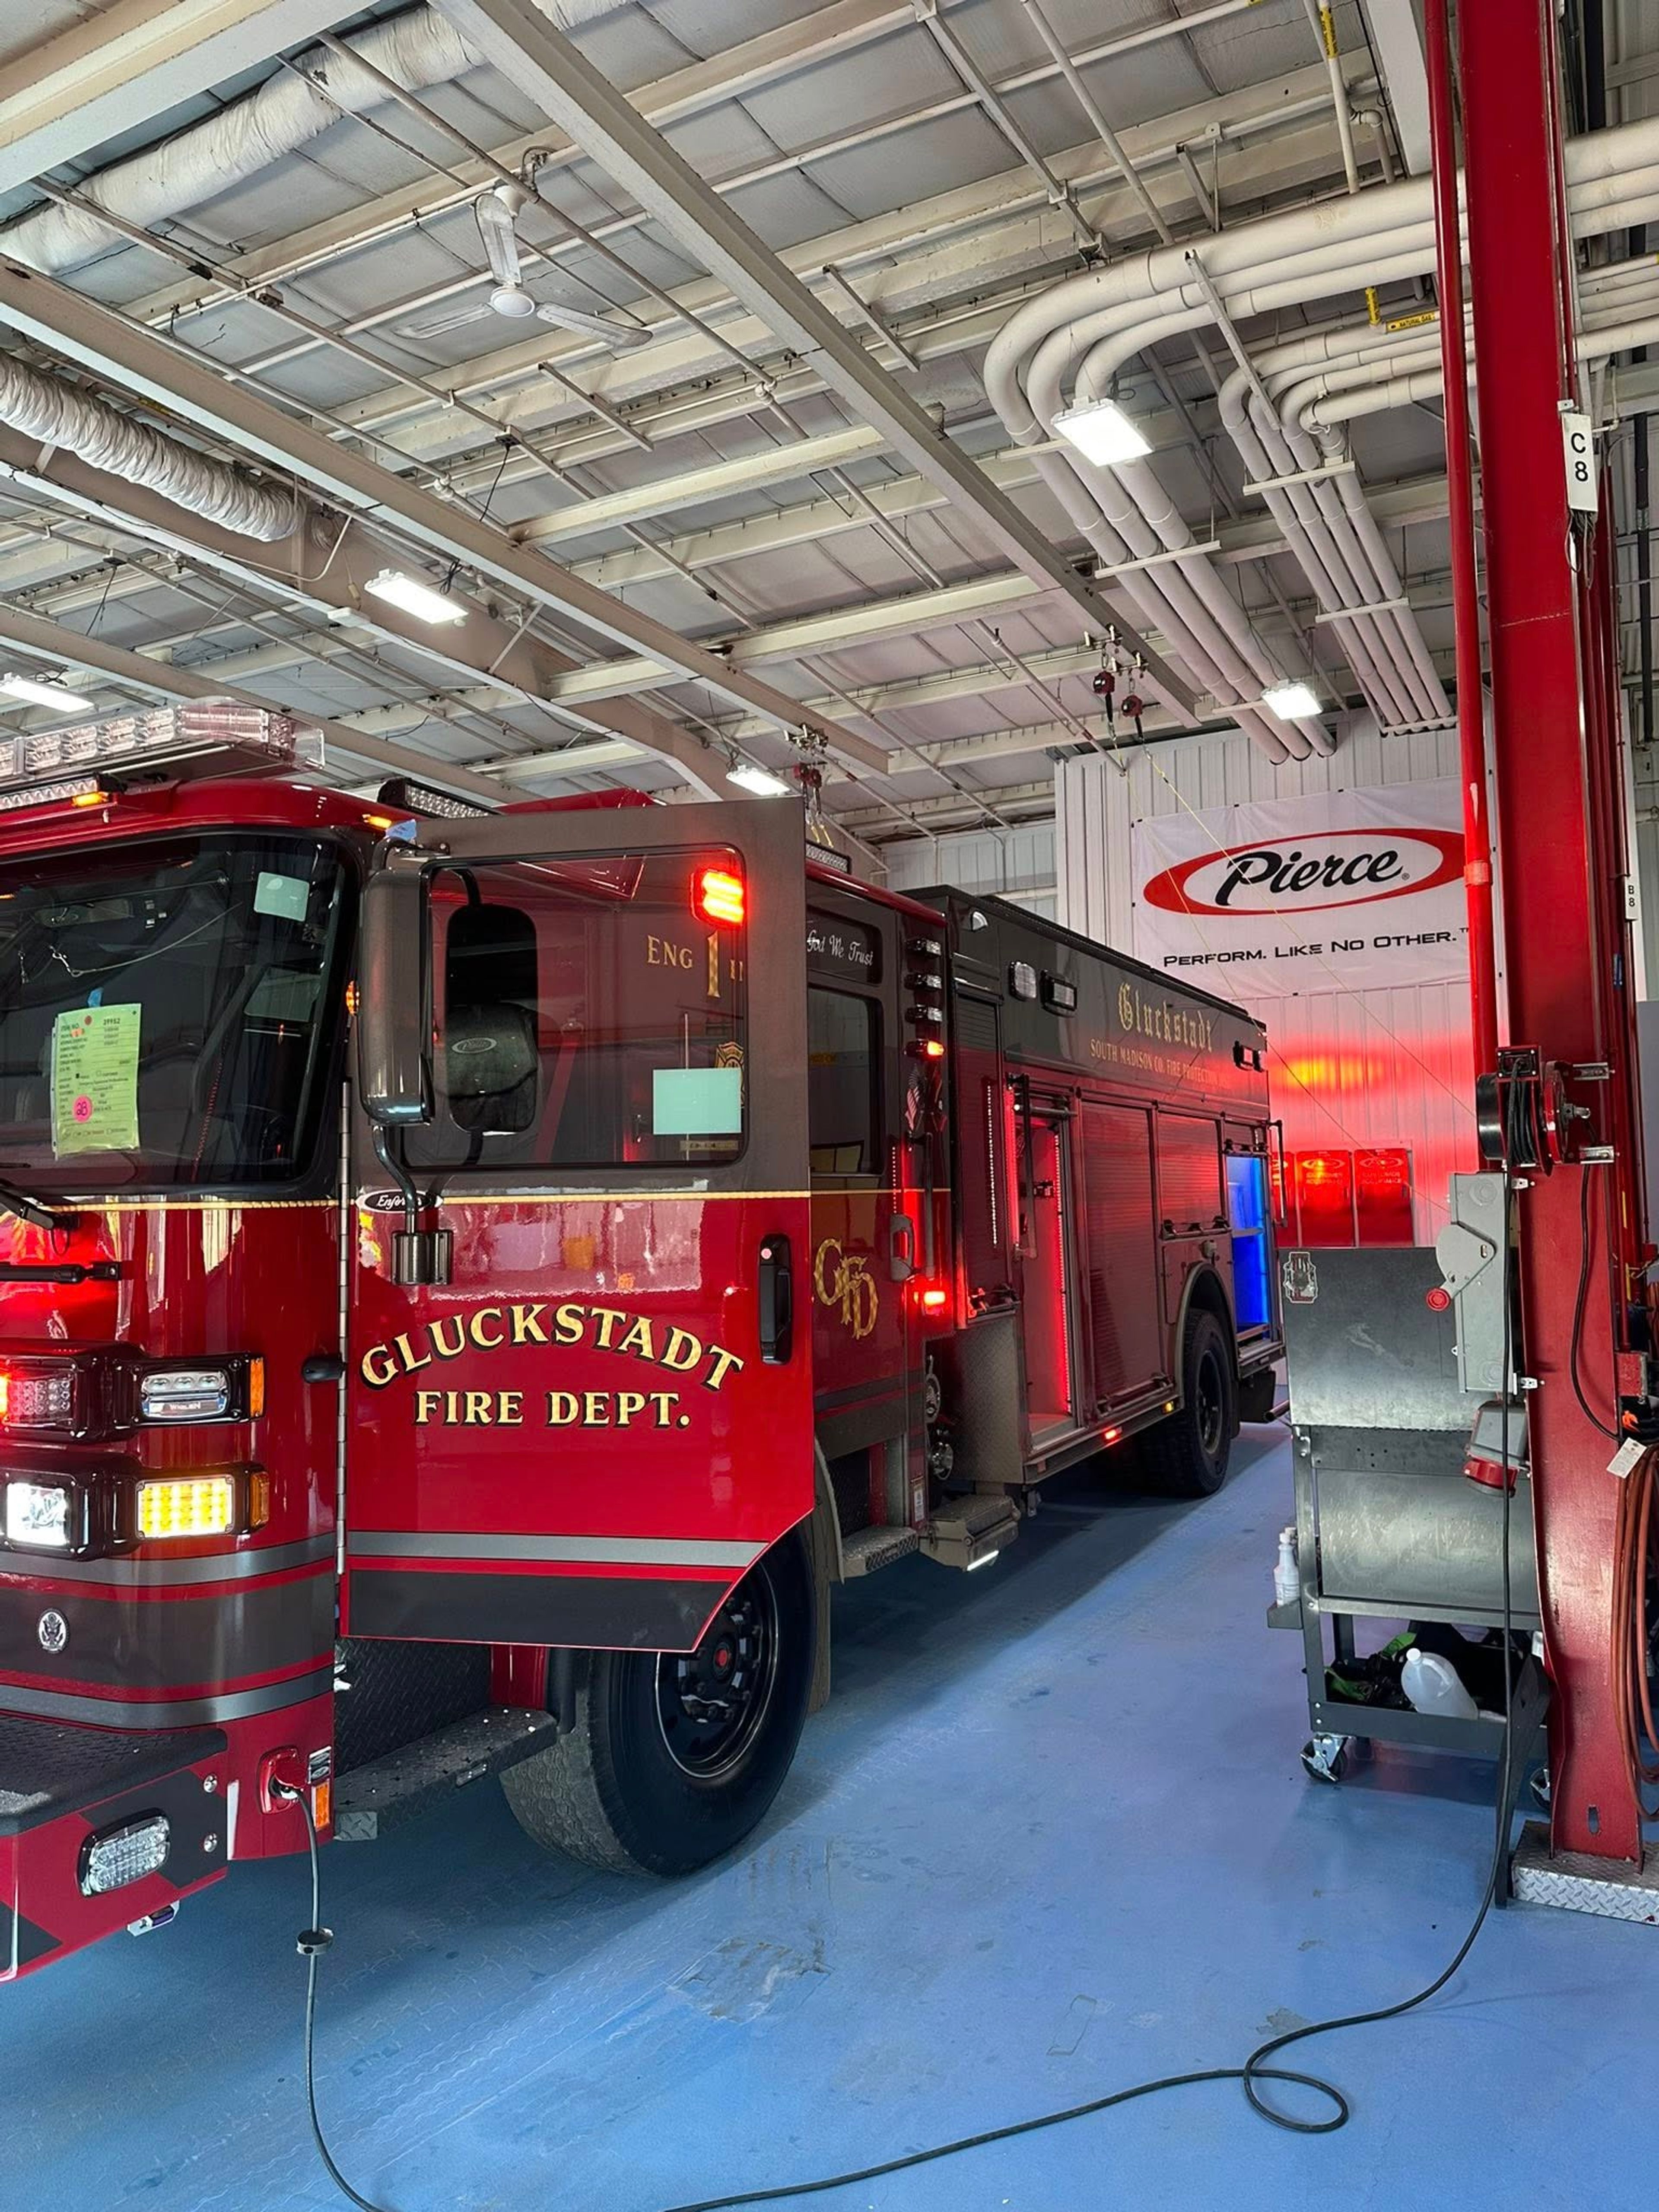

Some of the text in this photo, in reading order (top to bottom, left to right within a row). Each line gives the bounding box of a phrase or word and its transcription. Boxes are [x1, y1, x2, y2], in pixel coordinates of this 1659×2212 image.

[1571, 432, 1586, 454] C
[1575, 461, 1589, 482] 8
[1215, 849, 1403, 906] Pierce
[1628, 885, 1634, 894] B
[1629, 897, 1635, 907] 8
[647, 934, 693, 969] ENG
[829, 934, 844, 958] We
[848, 941, 874, 966] Trust
[1163, 948, 1266, 967] PERFORM.
[1275, 943, 1323, 958] LIKE
[1332, 939, 1364, 952] NO
[1090, 1039, 1118, 1062] SOUTH
[1119, 1047, 1153, 1070] MADISON
[1166, 1059, 1182, 1077] FIRE
[359, 1303, 745, 1392] GLUCKSTADT
[414, 1390, 691, 1428] FIRE DEPT.
